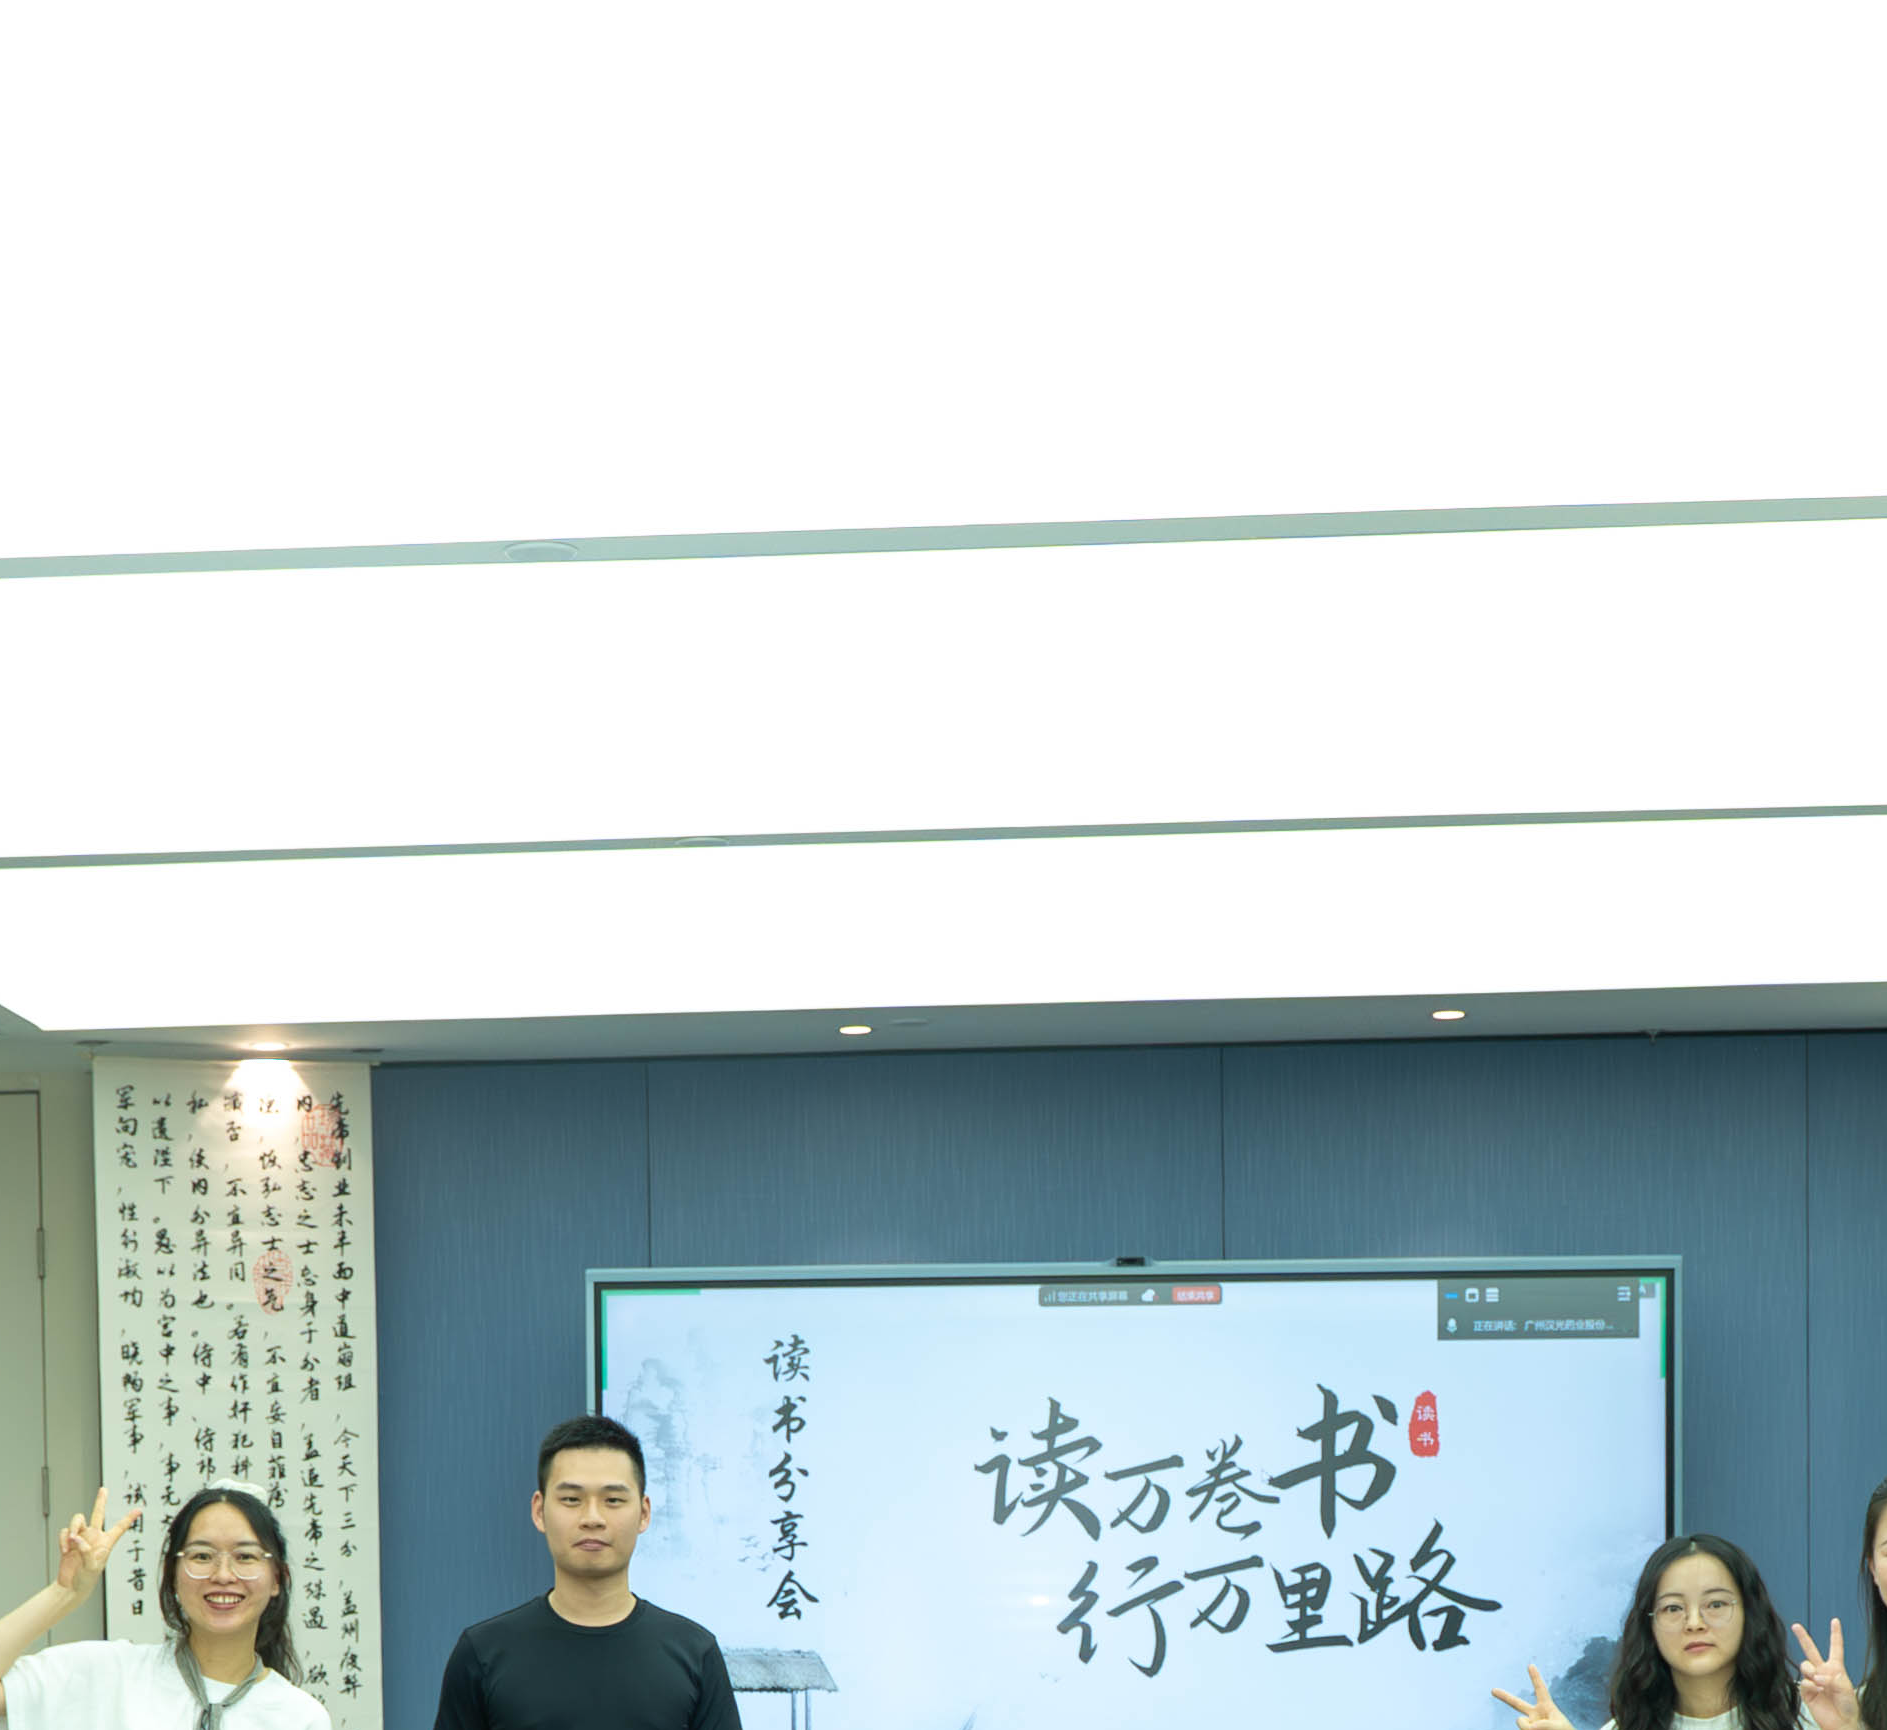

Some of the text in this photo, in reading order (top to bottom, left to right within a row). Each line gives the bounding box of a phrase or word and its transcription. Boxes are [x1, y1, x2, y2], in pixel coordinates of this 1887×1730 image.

[763, 1333, 820, 1620] 读书分享会
[974, 1383, 1400, 1541] 读万卷书
[1056, 1519, 1503, 1678] 行万里路
